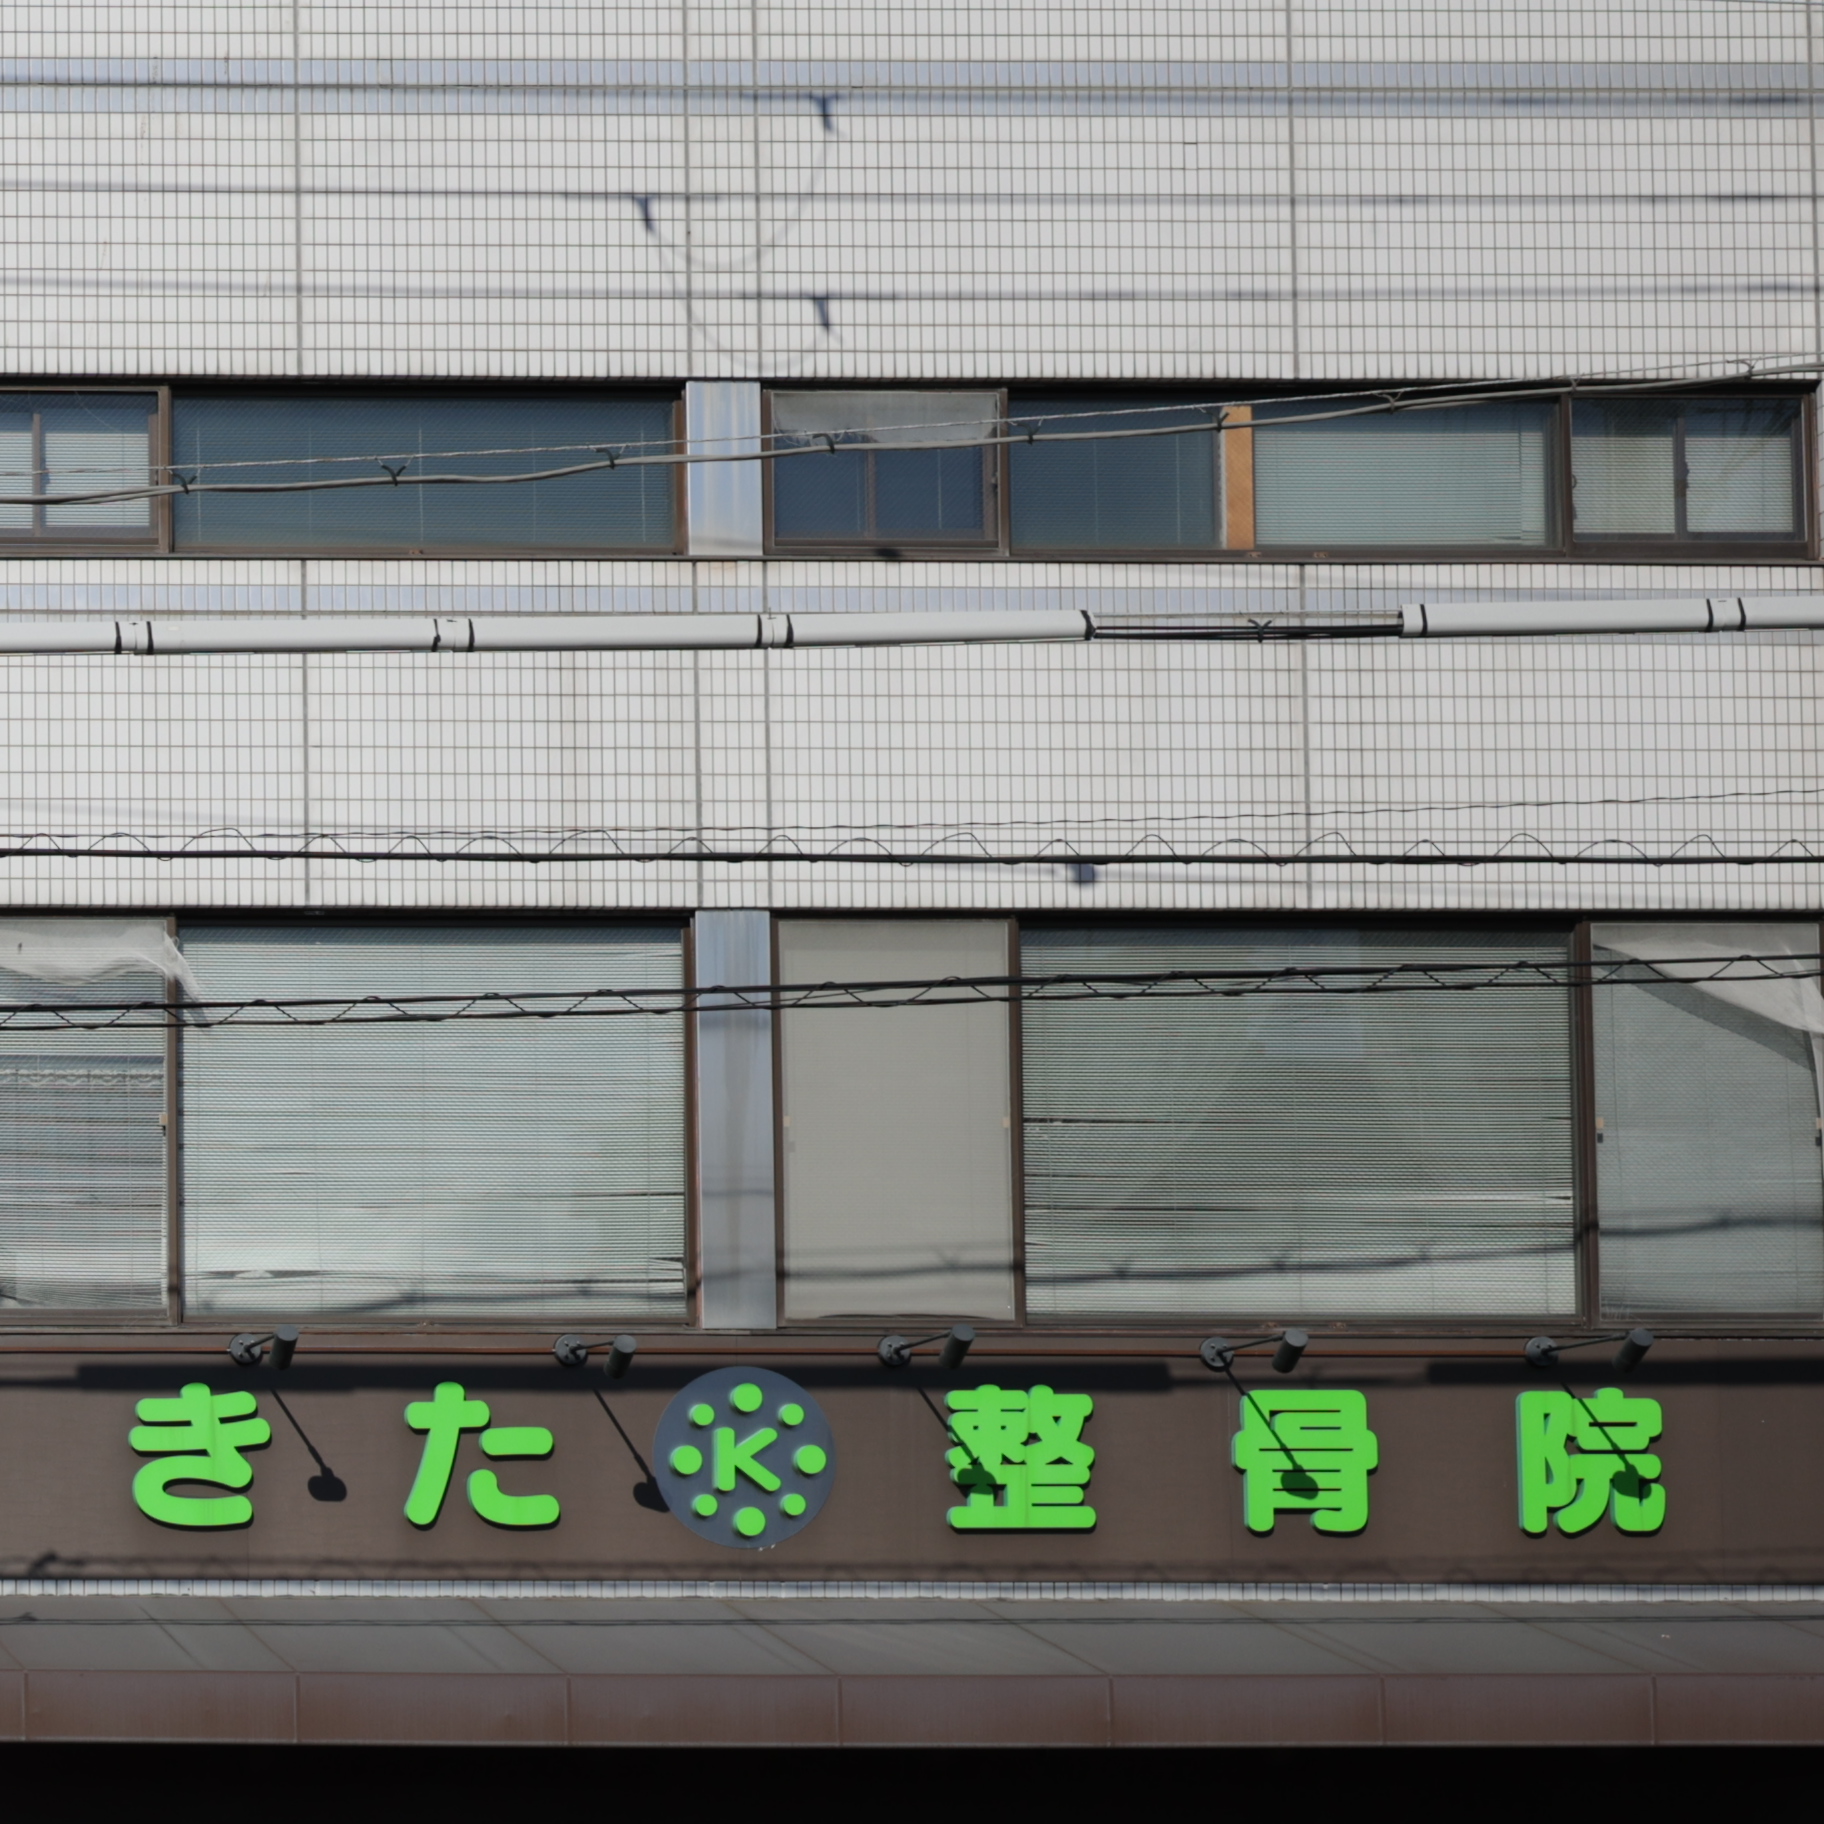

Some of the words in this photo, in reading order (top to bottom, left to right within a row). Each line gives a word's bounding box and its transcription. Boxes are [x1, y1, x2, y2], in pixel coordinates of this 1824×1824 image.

[129, 1381, 560, 1528] きた
[946, 1384, 1668, 1536] 整骨院
